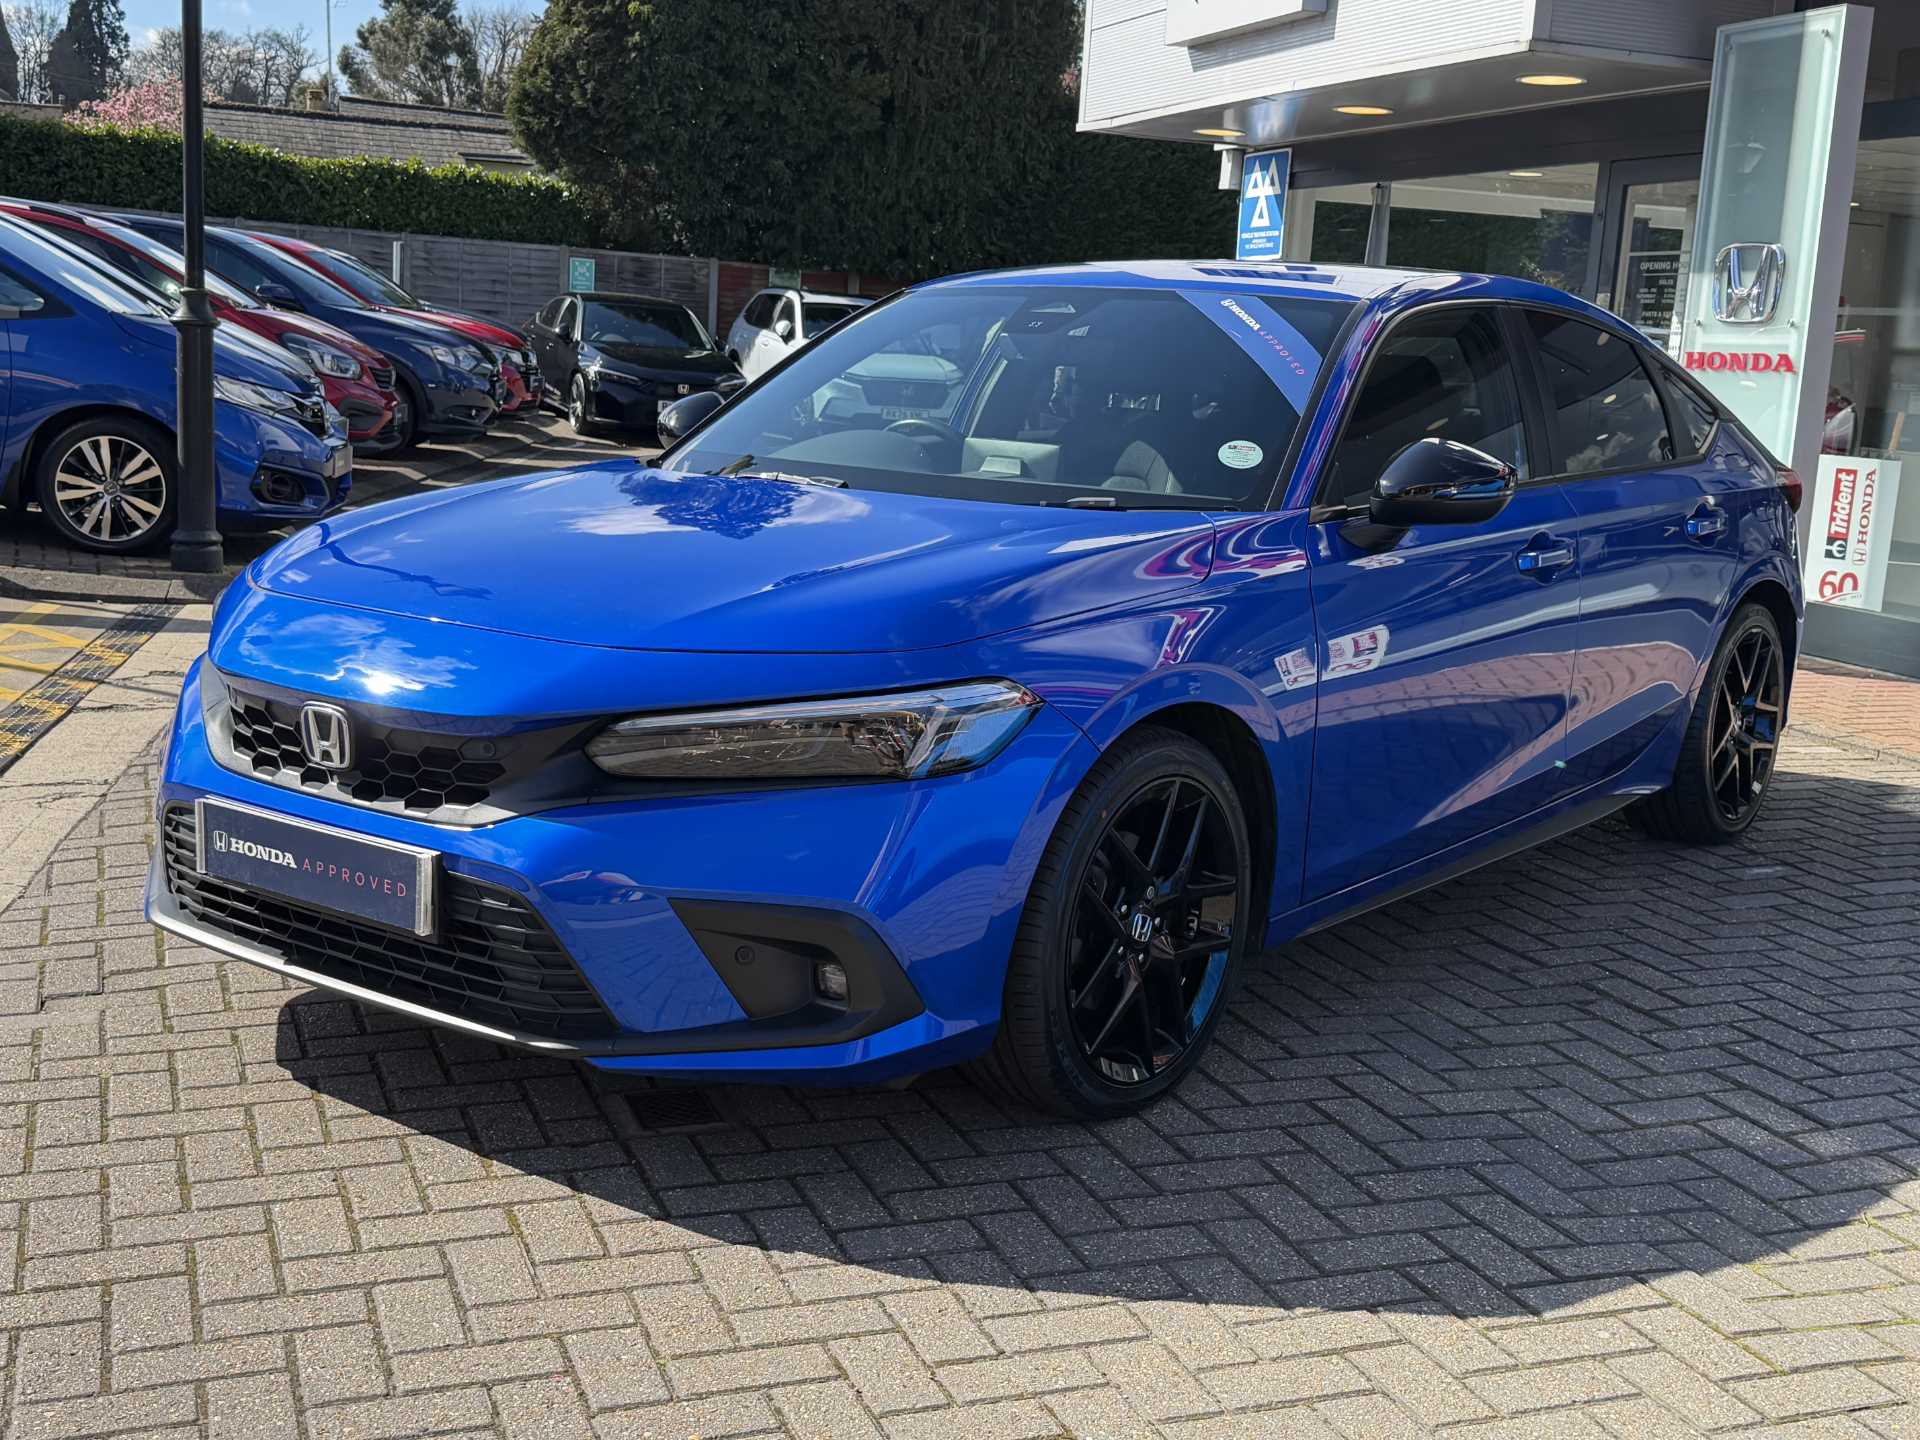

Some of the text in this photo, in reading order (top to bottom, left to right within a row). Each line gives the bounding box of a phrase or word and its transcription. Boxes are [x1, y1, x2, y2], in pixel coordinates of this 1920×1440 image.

[1640, 261, 1671, 271] OPENING
[1685, 351, 1796, 374] HONDA
[1830, 471, 1855, 535] Trident
[1857, 468, 1877, 545] HONDA
[229, 837, 298, 870] HONDA
[302, 857, 408, 898] APPROVED
